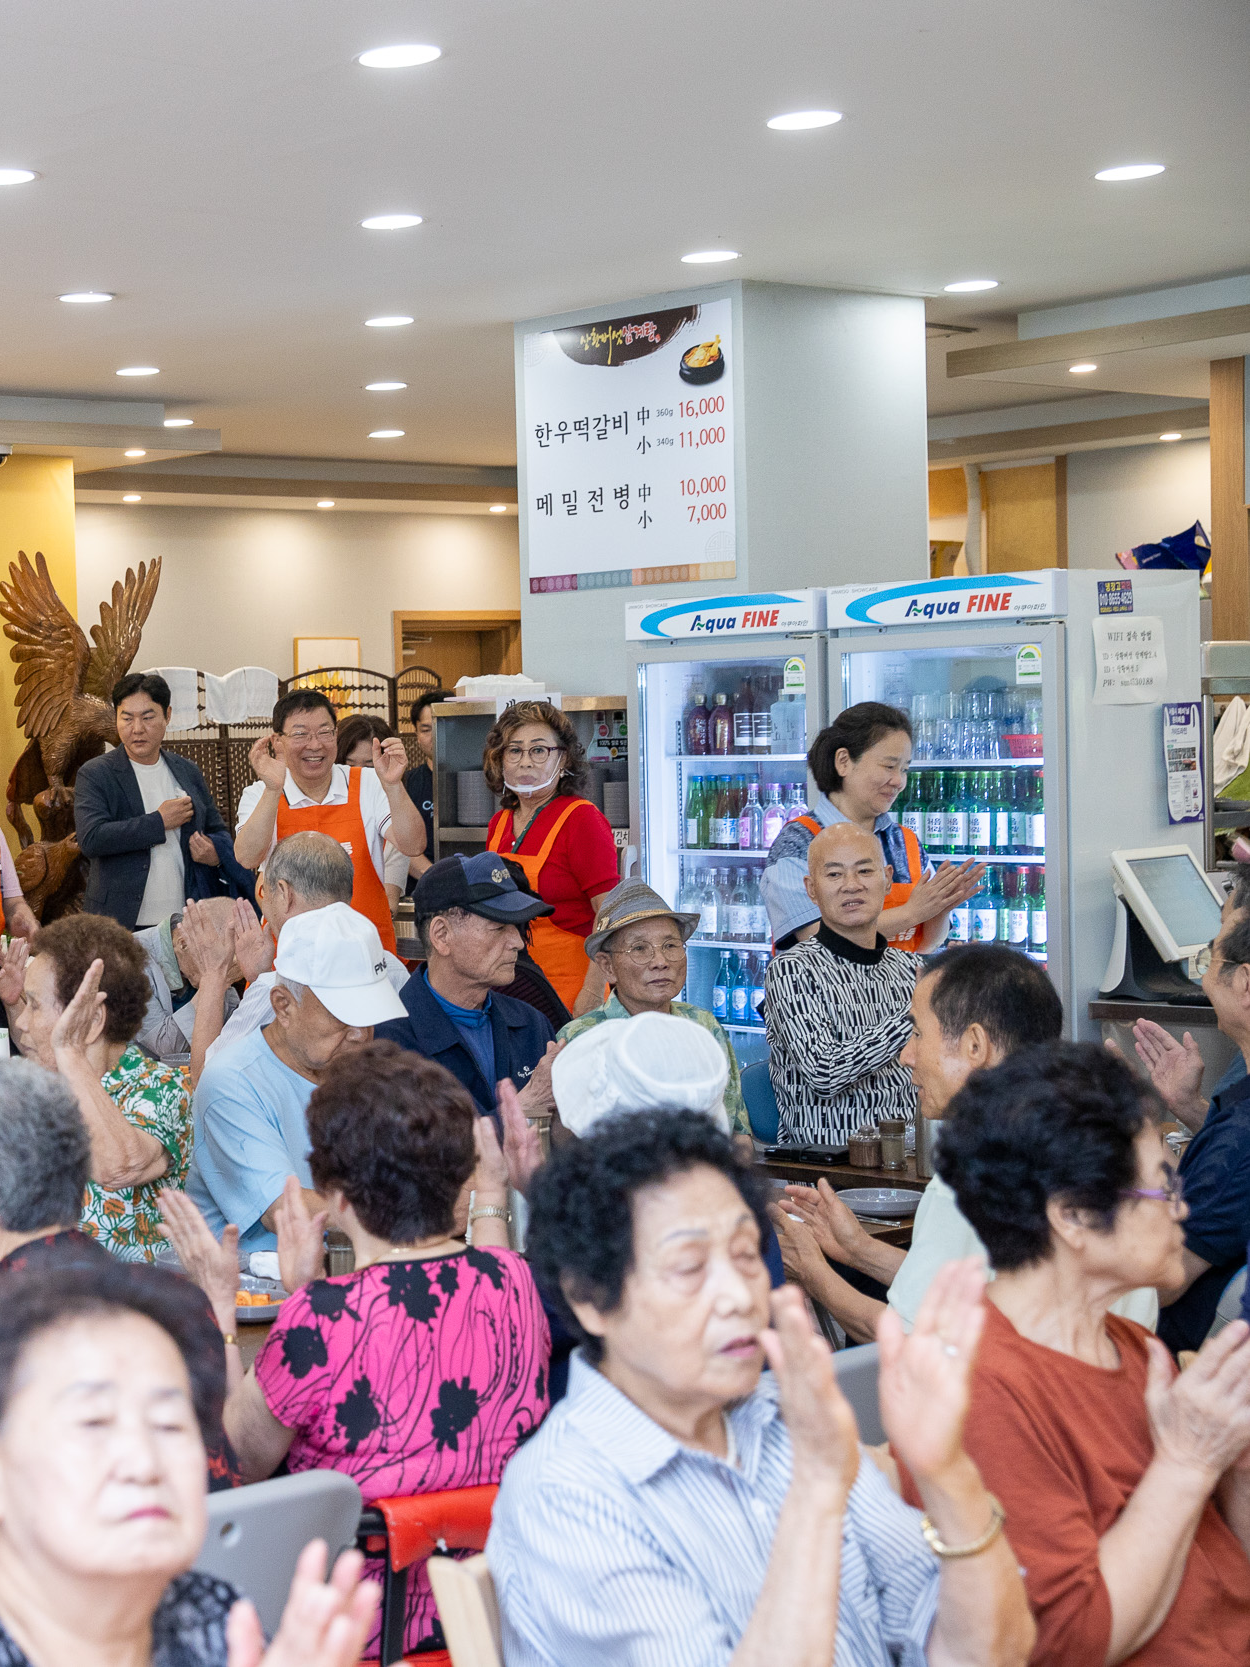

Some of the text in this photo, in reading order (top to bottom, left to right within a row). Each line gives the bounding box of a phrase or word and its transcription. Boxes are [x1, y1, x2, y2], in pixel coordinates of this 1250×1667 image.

[637, 407, 650, 425] 中
[679, 396, 724, 418] 16,000
[535, 411, 629, 448] 한우떡갈비
[636, 426, 725, 454] 小 340g 11,000
[536, 475, 726, 516] 메밀전병 中 10,000
[638, 503, 726, 529] 小 7,000
[904, 599, 960, 619] Aqua
[967, 592, 1012, 613] FINE
[690, 615, 736, 633] Aqua
[742, 609, 780, 628] FINE
[1107, 632, 1123, 641] WIFI
